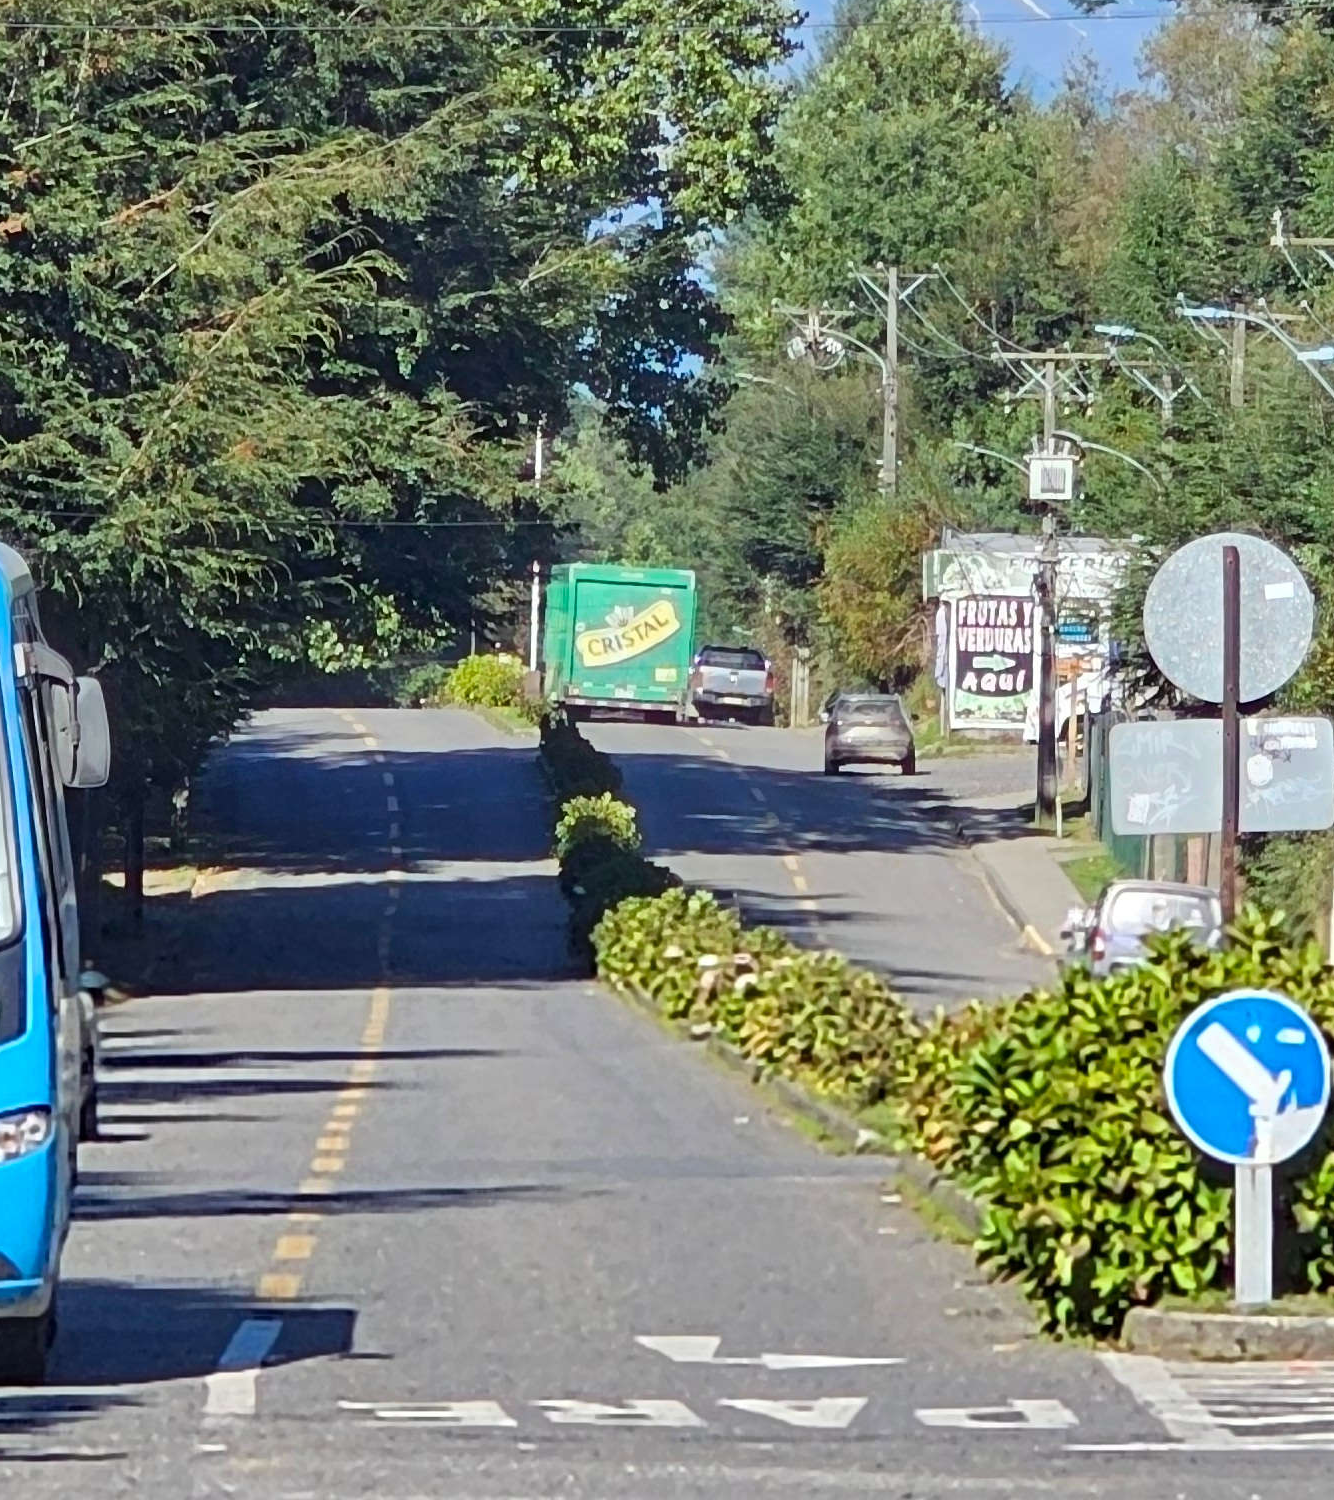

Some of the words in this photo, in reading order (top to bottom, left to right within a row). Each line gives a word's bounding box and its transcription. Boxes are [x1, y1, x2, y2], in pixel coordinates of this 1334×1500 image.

[957, 600, 1018, 626] FRUTAS
[1022, 601, 1034, 627] Y
[587, 613, 669, 658] CRISTAL
[957, 626, 1032, 654] VERDURAS
[337, 1398, 1080, 1429] PARE
